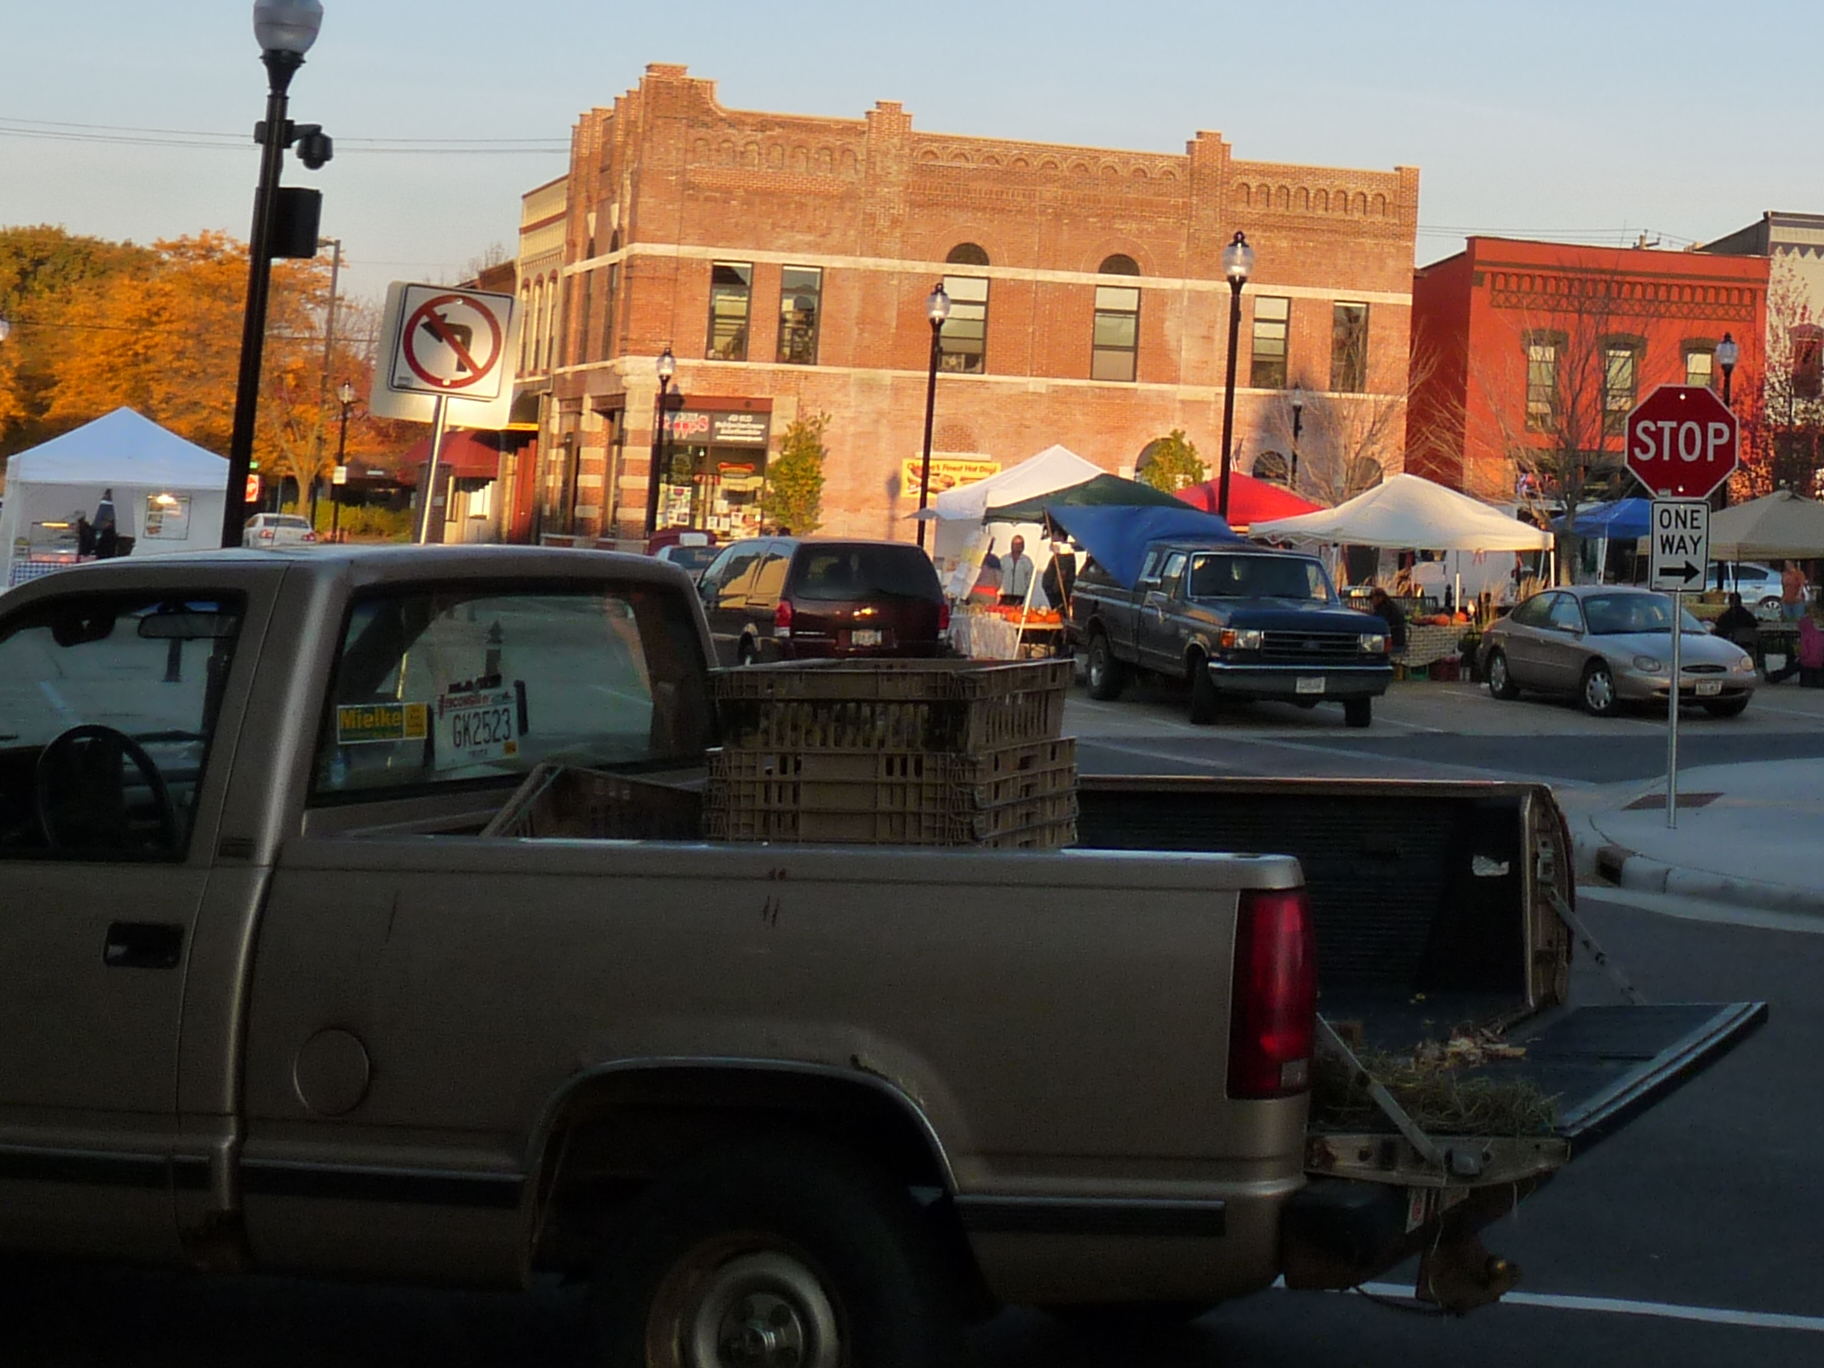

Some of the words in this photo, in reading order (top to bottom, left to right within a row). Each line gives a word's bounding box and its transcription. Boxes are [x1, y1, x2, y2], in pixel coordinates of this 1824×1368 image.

[1633, 420, 1730, 462] STOP
[1659, 508, 1702, 530] ONE
[1660, 534, 1702, 556] WAY
[340, 706, 402, 730] Mielke
[452, 707, 512, 749] GK2523
